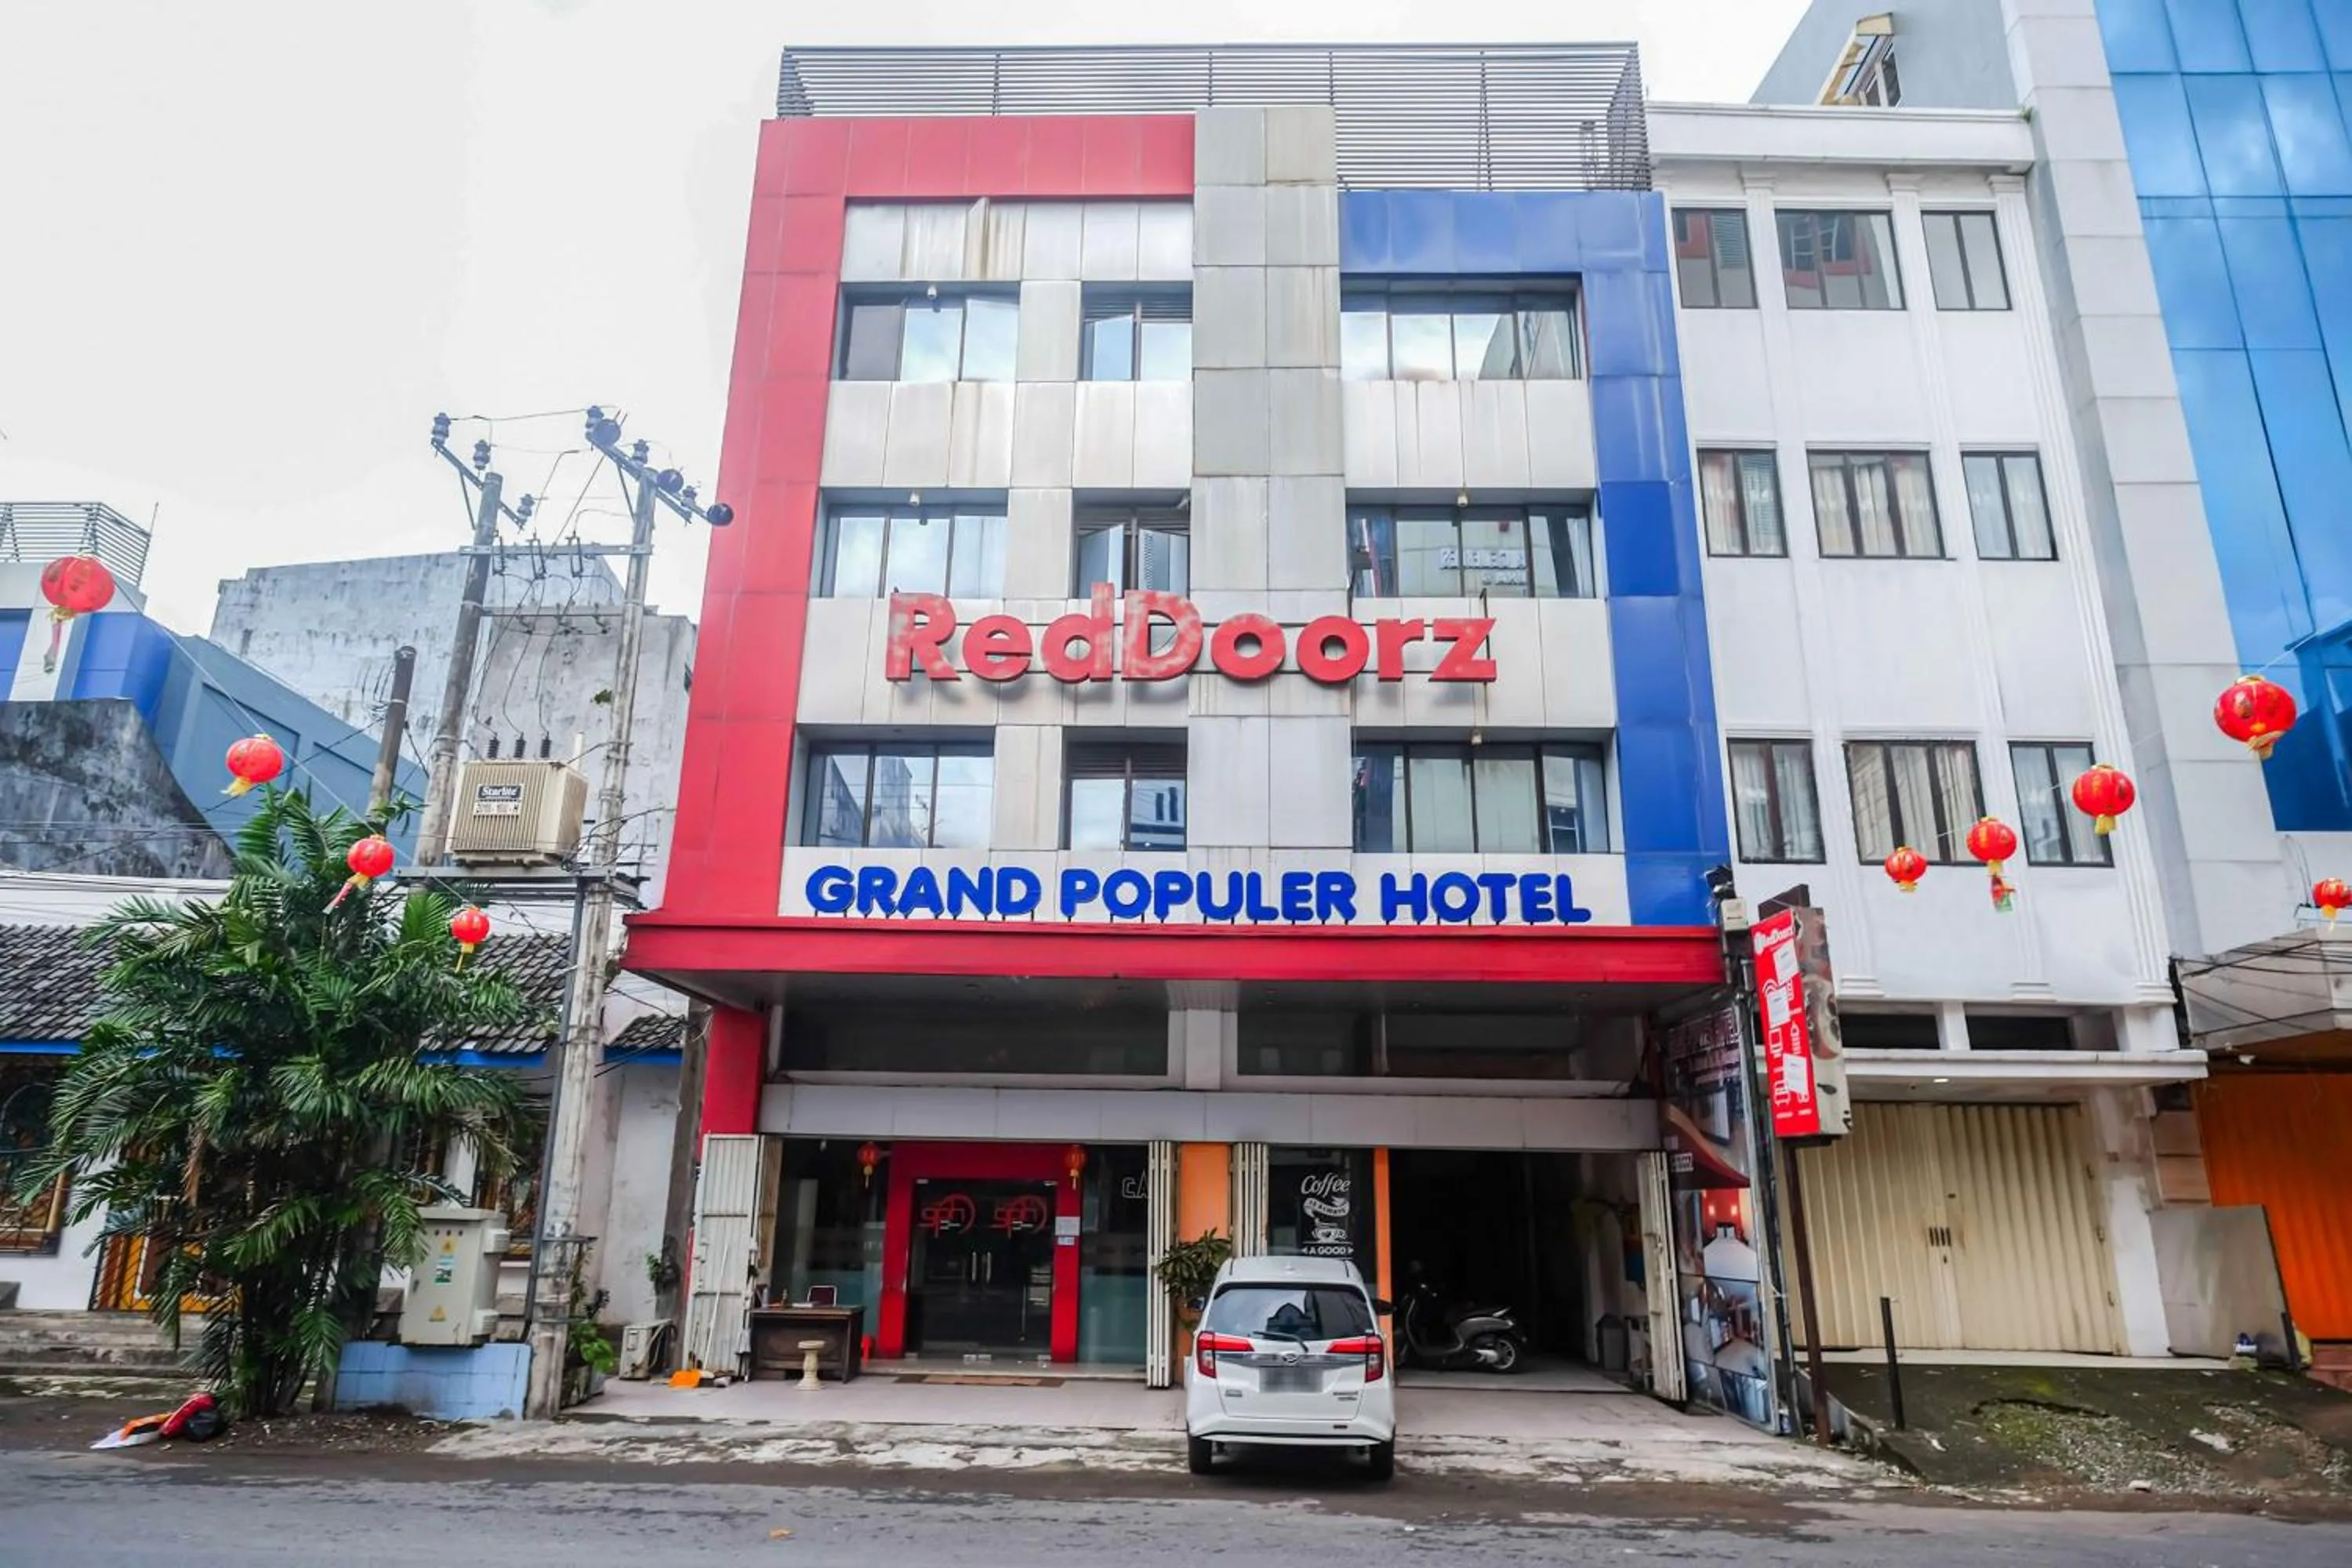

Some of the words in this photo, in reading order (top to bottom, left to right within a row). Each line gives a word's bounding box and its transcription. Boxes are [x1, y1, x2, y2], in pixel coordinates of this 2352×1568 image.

[886, 583, 1497, 683] RedDoorz
[804, 864, 1042, 916] GRAND
[1059, 868, 1356, 922] POPULER
[1379, 872, 1592, 924] HOTEL
[1301, 1172, 1352, 1198] Coffee
